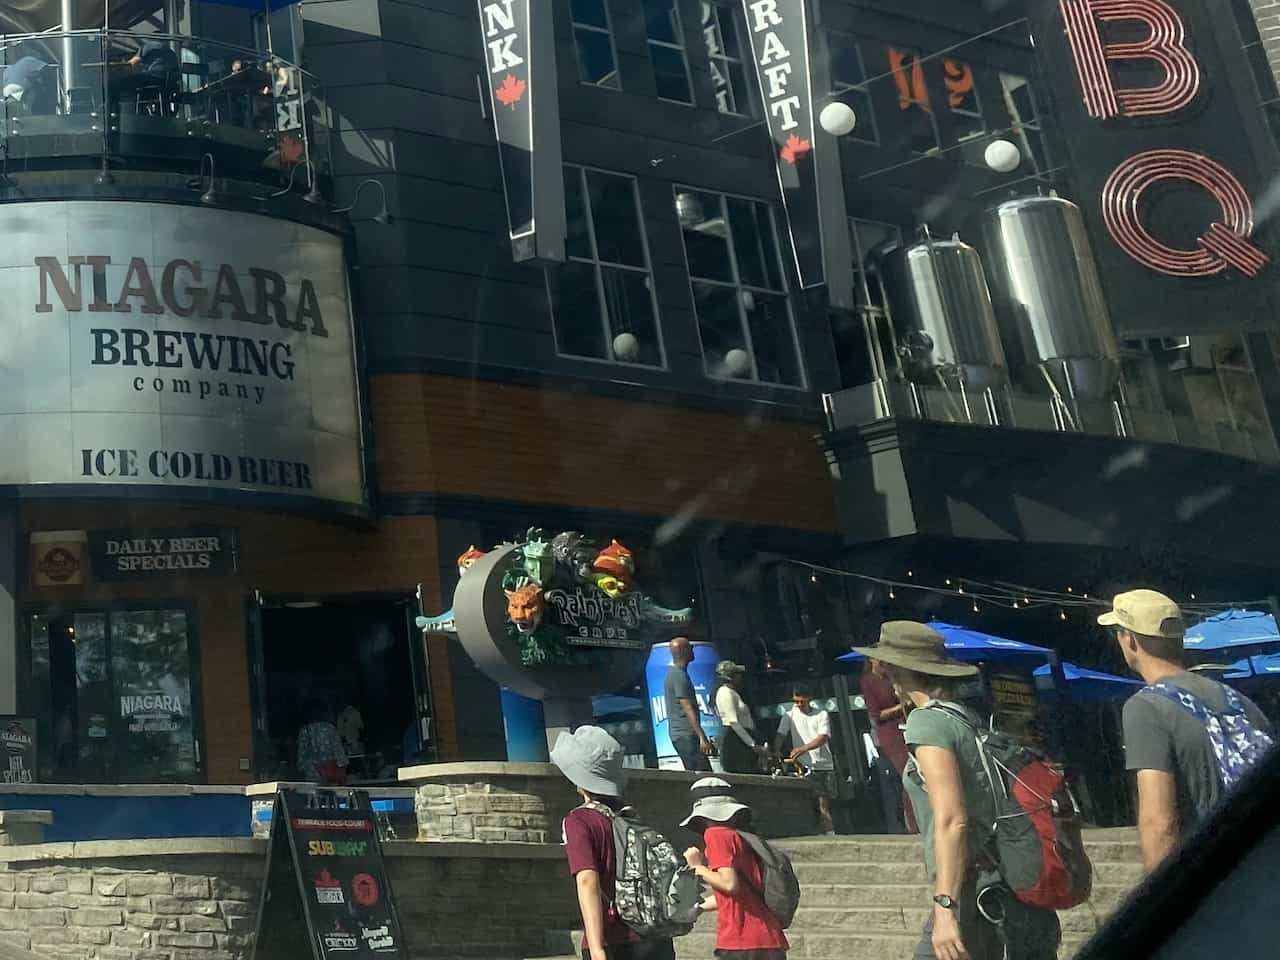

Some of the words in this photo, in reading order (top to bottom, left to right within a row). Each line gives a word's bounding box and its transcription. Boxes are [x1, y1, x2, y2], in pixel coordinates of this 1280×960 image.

[34, 255, 329, 338] NIAGARA
[90, 328, 296, 381] BREWING
[133, 376, 266, 405] company
[81, 448, 139, 476] ICE
[148, 449, 232, 481] COLD
[238, 456, 313, 489] BEER
[105, 539, 164, 555] DAILY
[168, 536, 220, 553] BEER
[117, 553, 211, 571] SPECIALS
[121, 695, 184, 718] NIAGARA
[308, 840, 367, 856] SUBWAY
